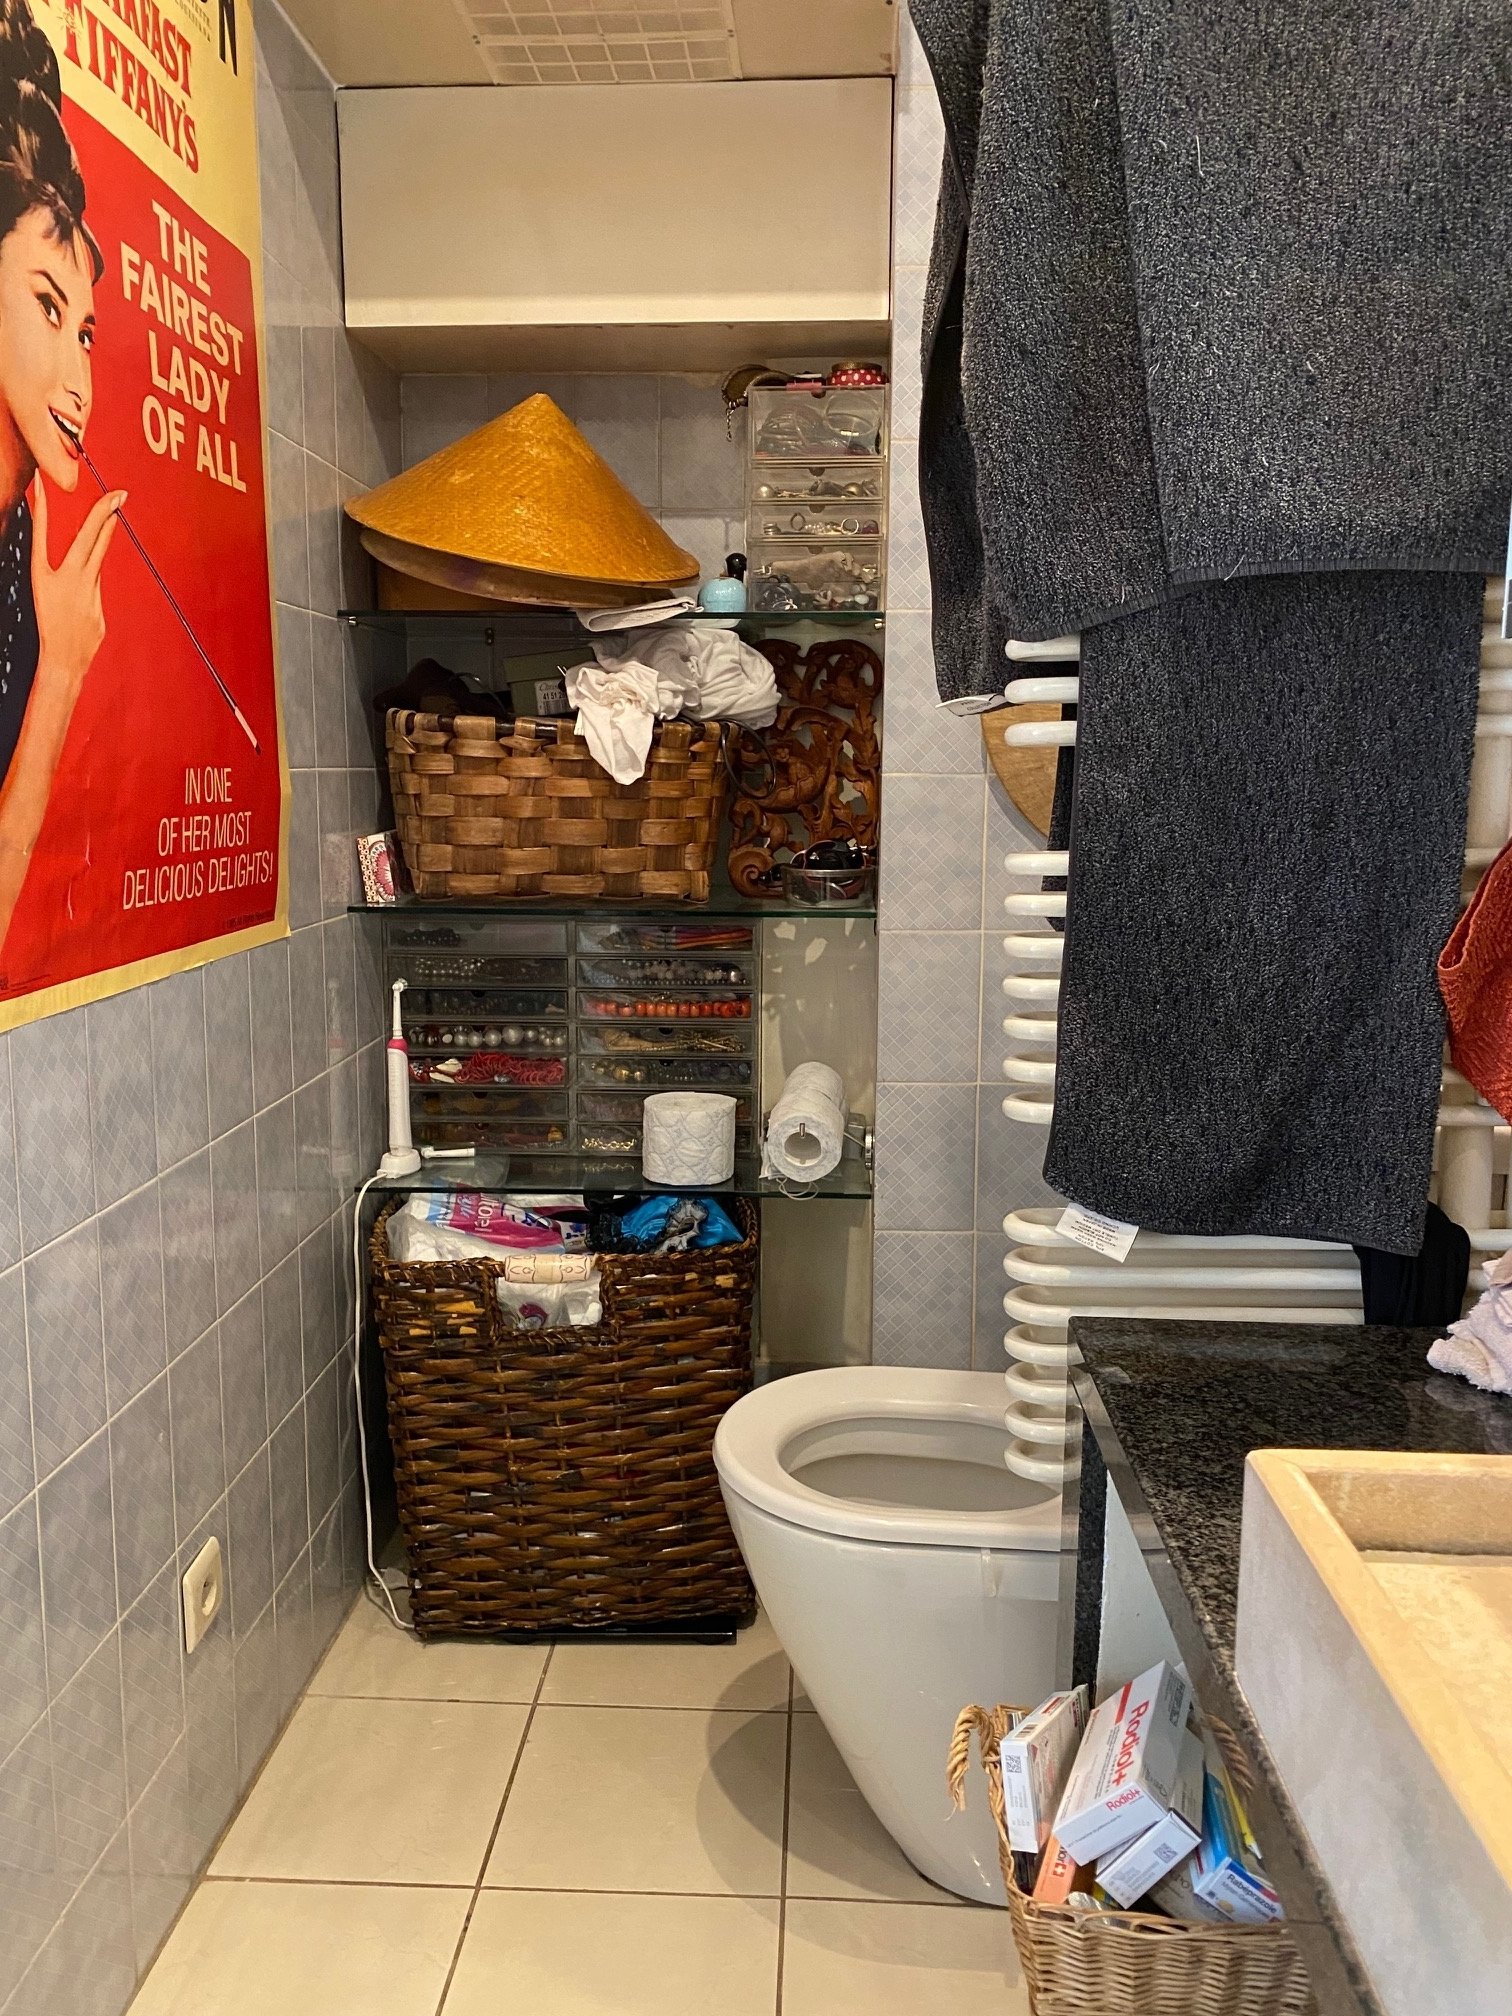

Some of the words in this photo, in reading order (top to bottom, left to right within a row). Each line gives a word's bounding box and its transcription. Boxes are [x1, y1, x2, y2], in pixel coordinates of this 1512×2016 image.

[64, 0, 198, 173] TIFFANY'S
[152, 199, 211, 297] THE
[120, 240, 244, 376] FAIREST
[149, 329, 230, 425] LADY
[142, 394, 186, 461] OF
[196, 423, 248, 494] ALL
[185, 767, 200, 804] IN
[204, 766, 232, 803] ONE
[158, 817, 180, 856] OF
[181, 815, 210, 853] HER
[213, 811, 252, 849] MOST
[122, 861, 204, 911] DELICIOUS
[208, 850, 273, 894] DELIGHTS!
[1112, 1700, 1150, 1786] Rodiol+
[1106, 1787, 1142, 1812] Rodiol+
